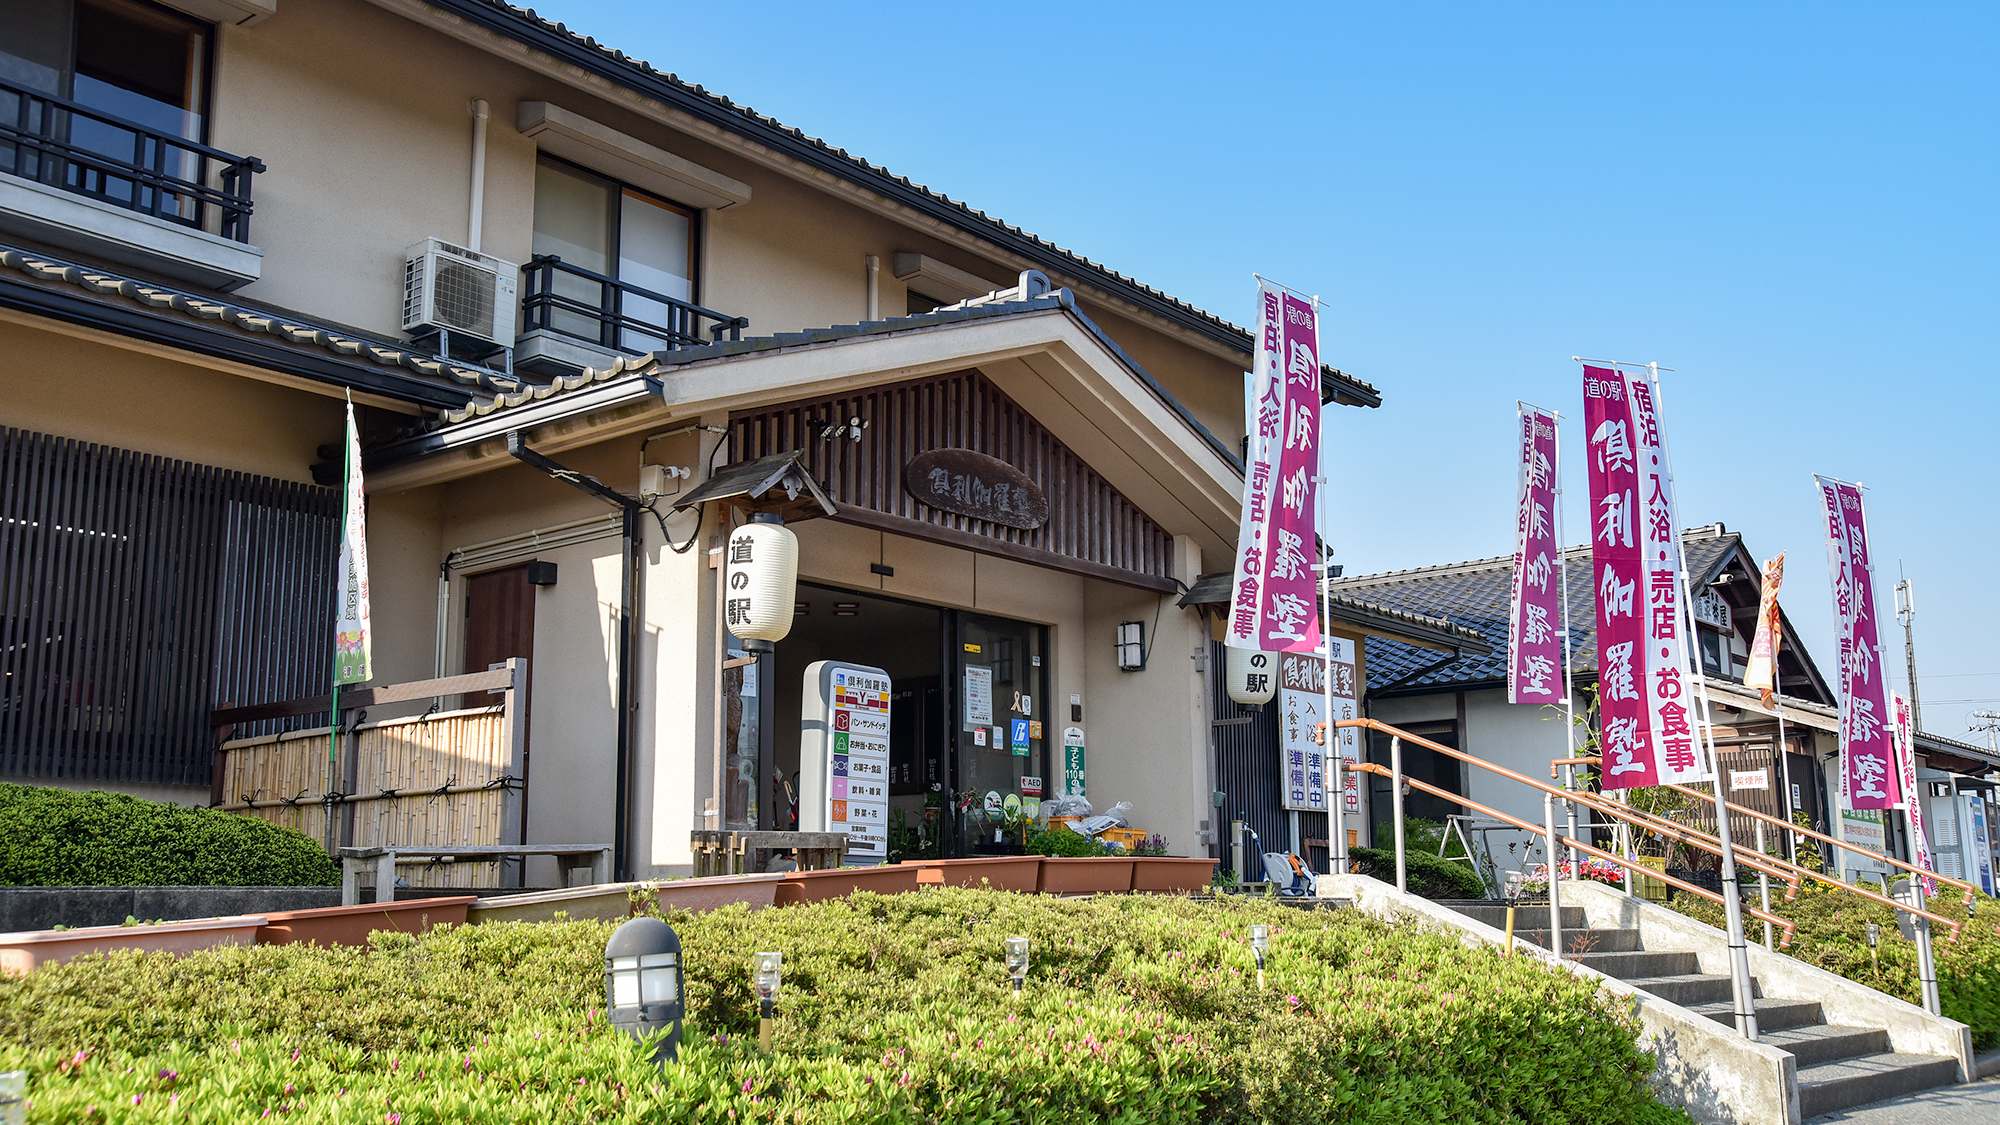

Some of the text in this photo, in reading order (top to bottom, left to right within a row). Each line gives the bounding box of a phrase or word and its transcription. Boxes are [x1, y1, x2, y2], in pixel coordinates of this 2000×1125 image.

[1584, 376, 1625, 401] 道の駅
[928, 467, 1031, 517] 倶利伽羅塾
[728, 536, 755, 626] 道の駅
[1632, 380, 1696, 773] 宿泊・入浴・売店・お食事
[1590, 420, 1646, 776] 倶利伽羅塾
[848, 676, 888, 692] 倶利伽羅塾
[851, 718, 886, 730] パン・サンドイッチ
[1287, 695, 1299, 743] お食事
[1305, 702, 1317, 743] 入浴
[850, 740, 886, 752] お弁当・おにぎり
[853, 763, 881, 774] お菓子・食品
[1290, 751, 1304, 806] 準備中
[1308, 753, 1322, 807] 準備中
[1734, 775, 1763, 786] 喫煙所
[852, 786, 881, 796] 飲料・雑貨
[1028, 779, 1041, 787] AED
[854, 808, 878, 818] 野菜・花
